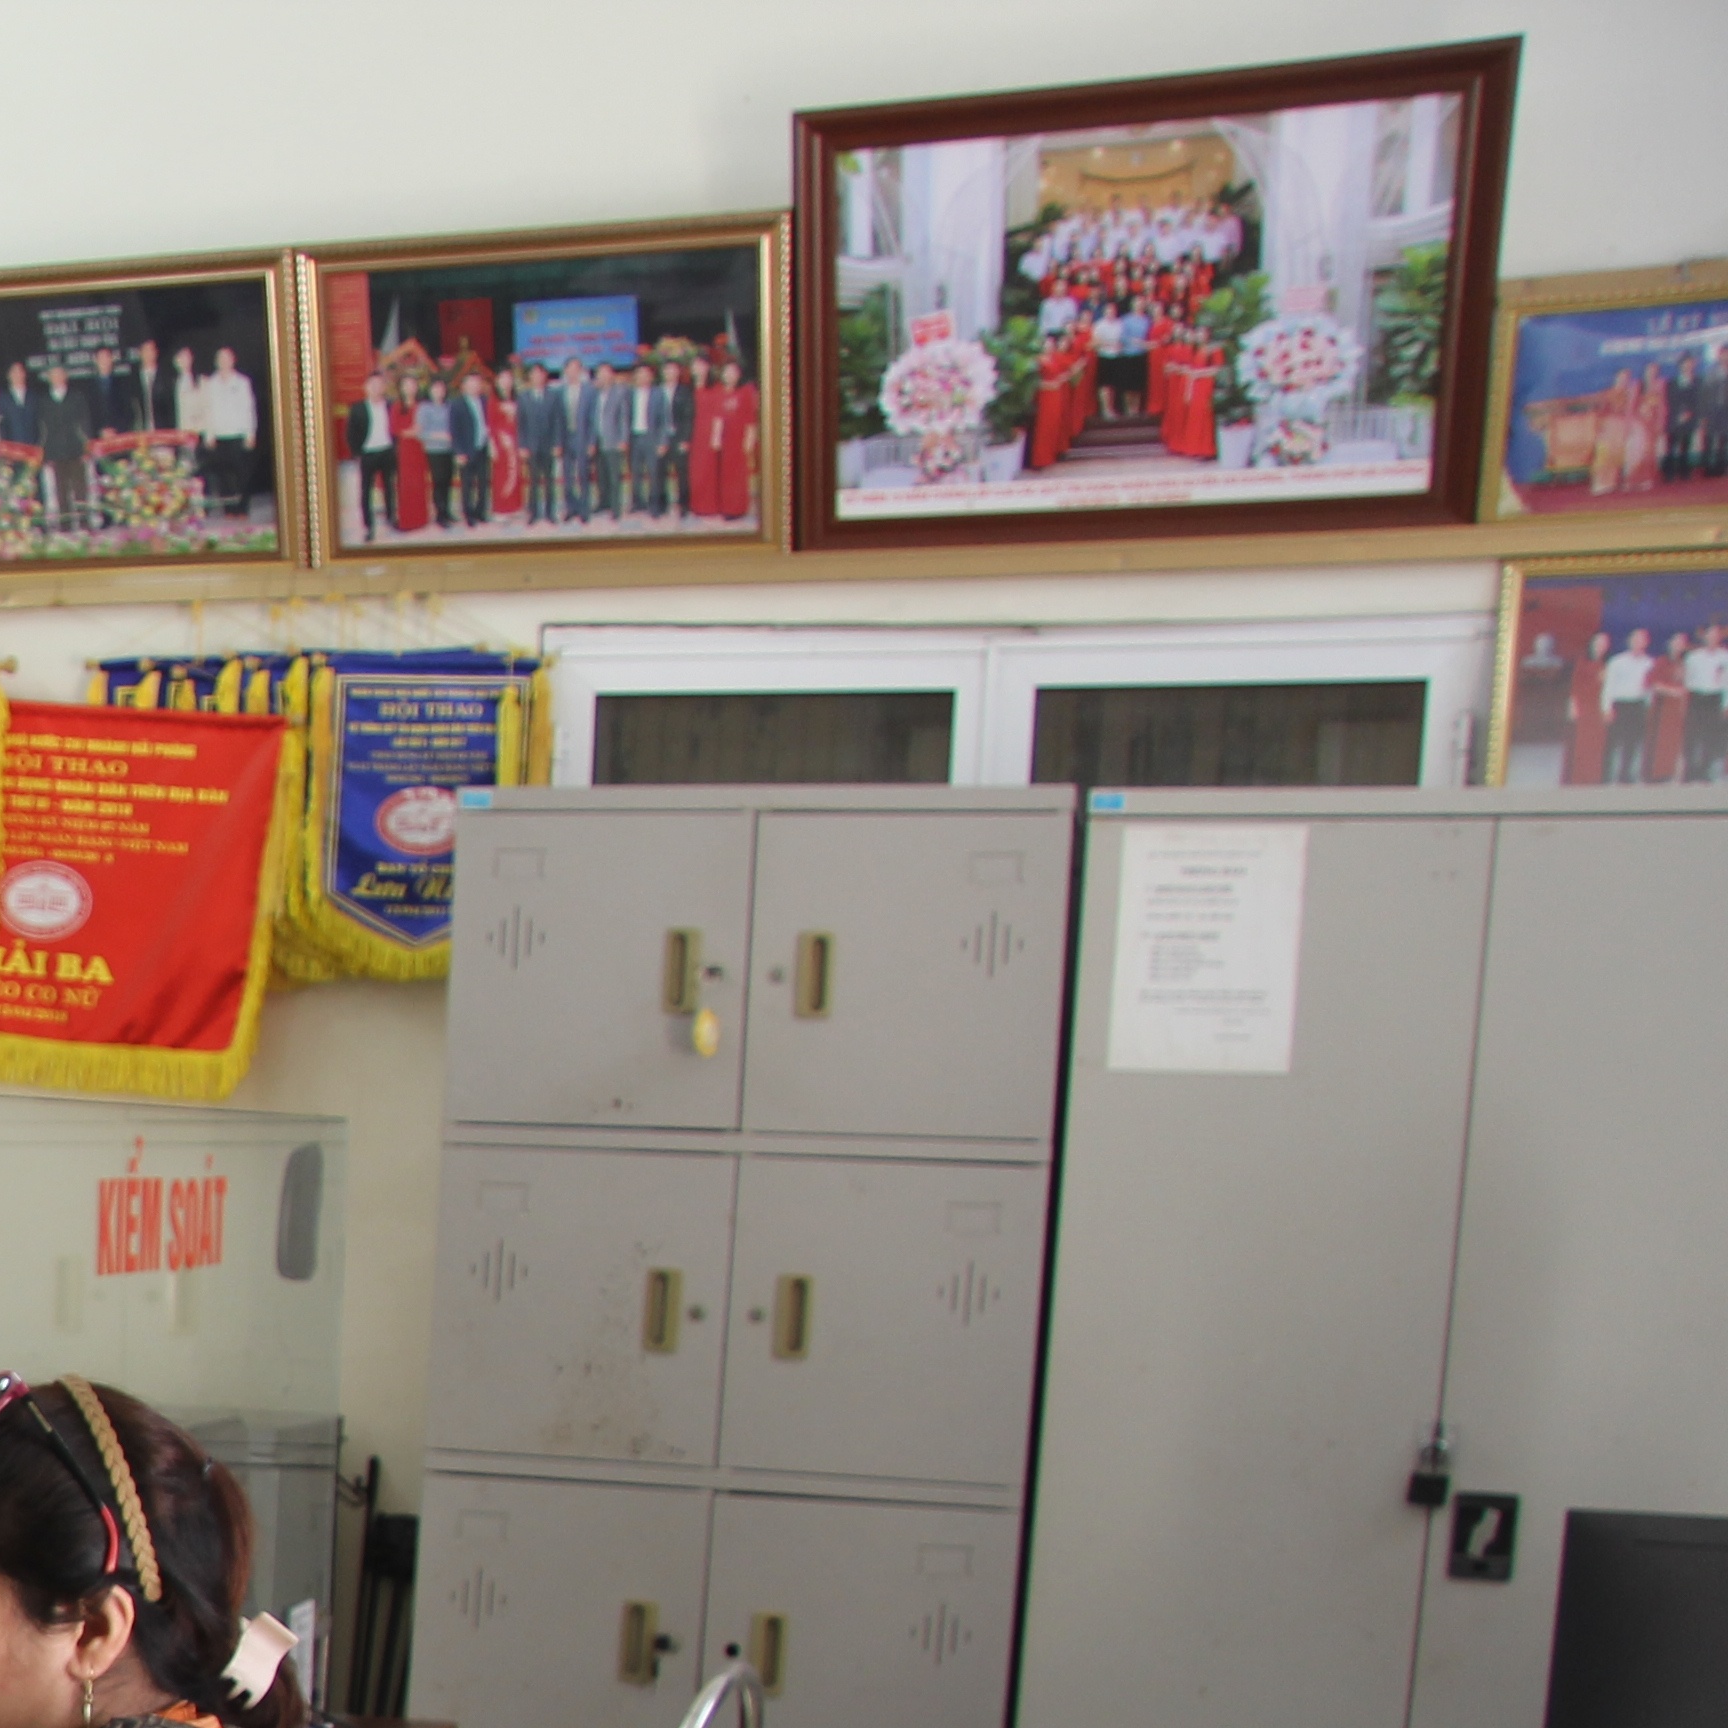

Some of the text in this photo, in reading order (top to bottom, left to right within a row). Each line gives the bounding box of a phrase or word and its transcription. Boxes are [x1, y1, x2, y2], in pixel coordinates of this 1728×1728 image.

[55, 951, 115, 985] BA
[95, 1135, 229, 1277] KIỂM SOÁT
